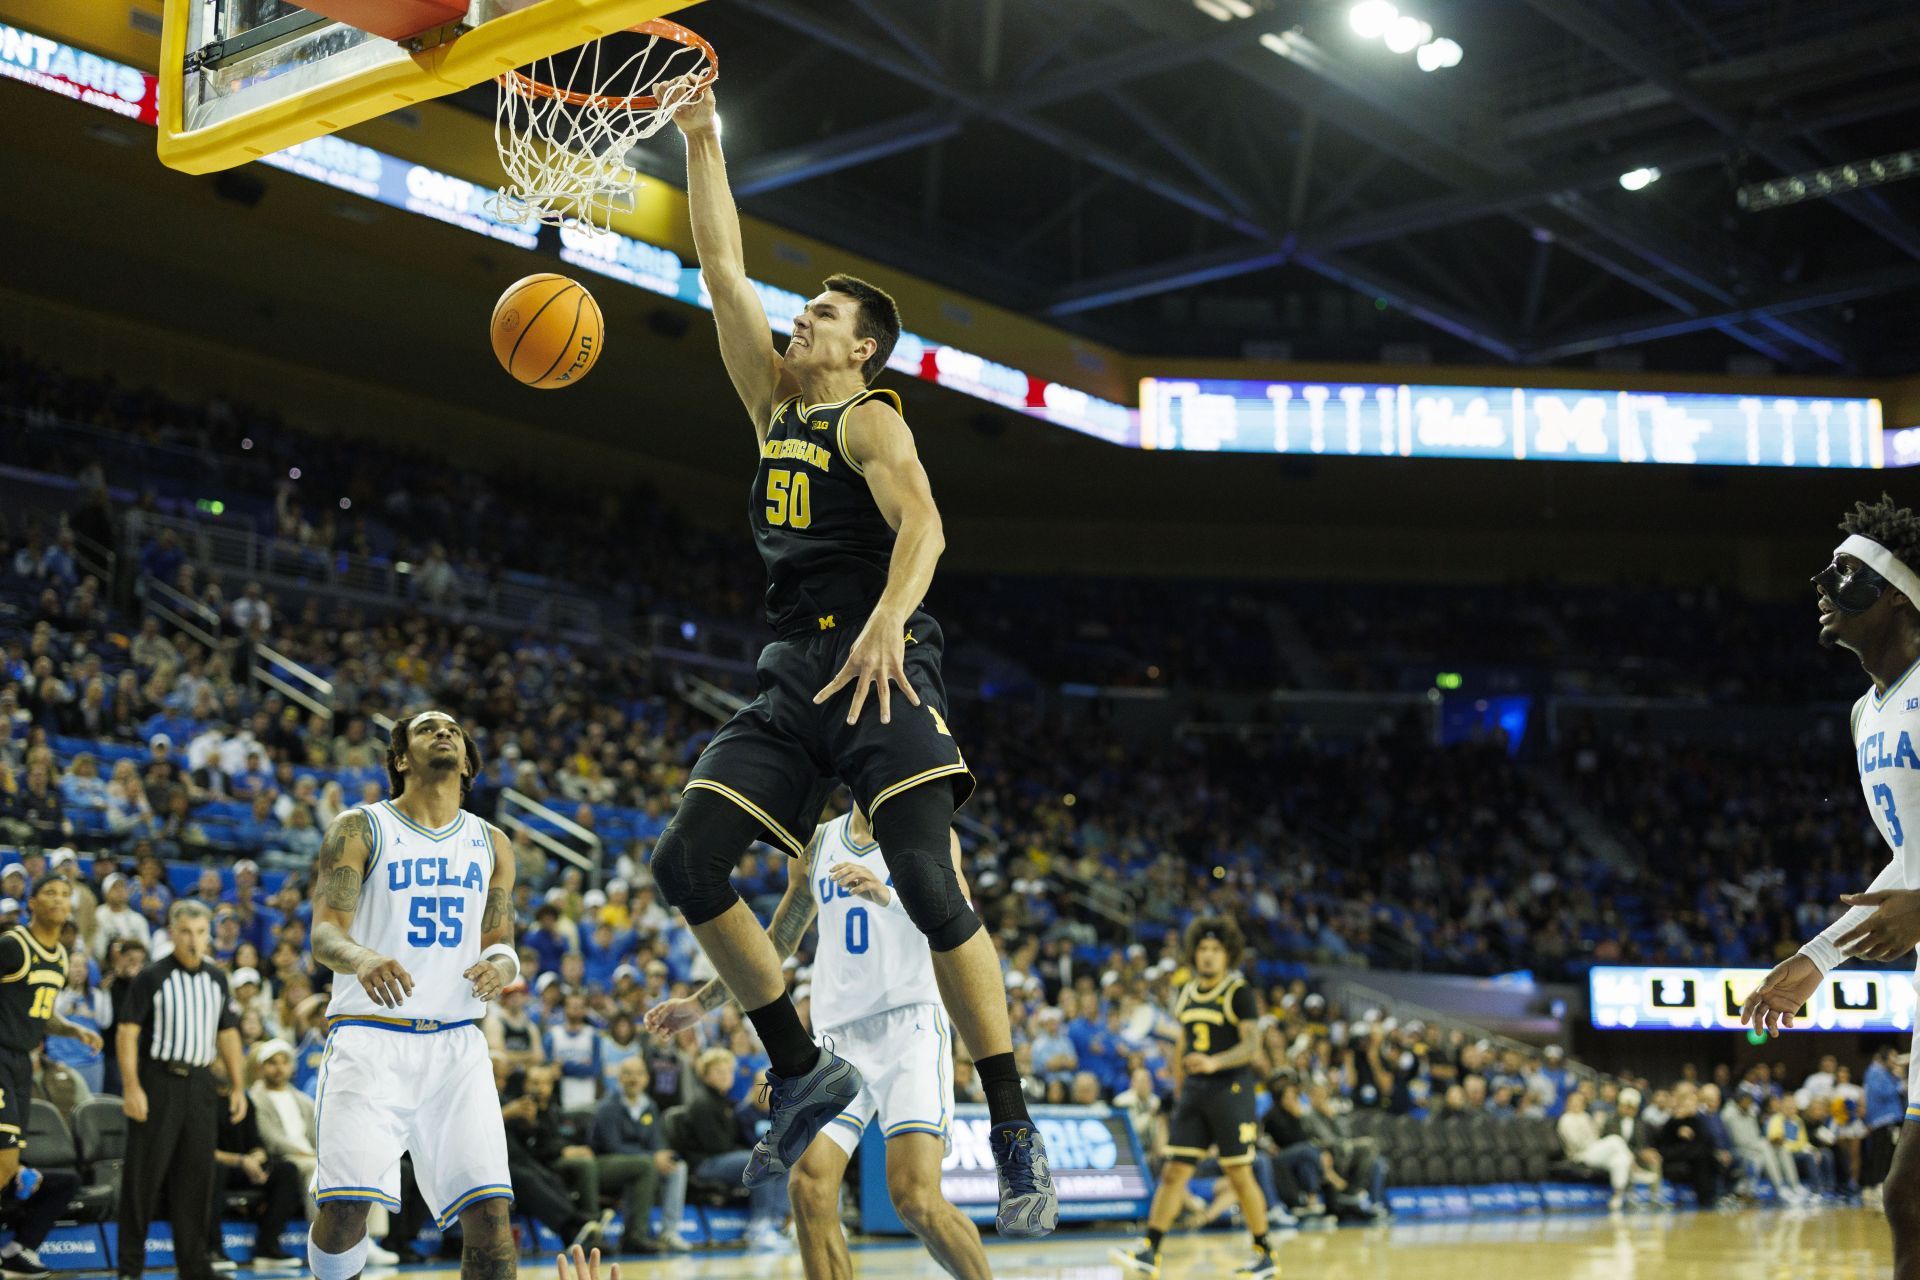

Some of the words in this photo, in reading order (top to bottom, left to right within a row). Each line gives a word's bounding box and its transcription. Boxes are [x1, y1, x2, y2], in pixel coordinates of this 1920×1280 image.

[555, 335, 593, 381] UCLA
[766, 468, 811, 529] 50
[818, 615, 835, 631] M
[1872, 783, 1904, 847] 3
[387, 857, 483, 894] UCLA
[407, 896, 465, 948] 55
[845, 906, 869, 955] 0
